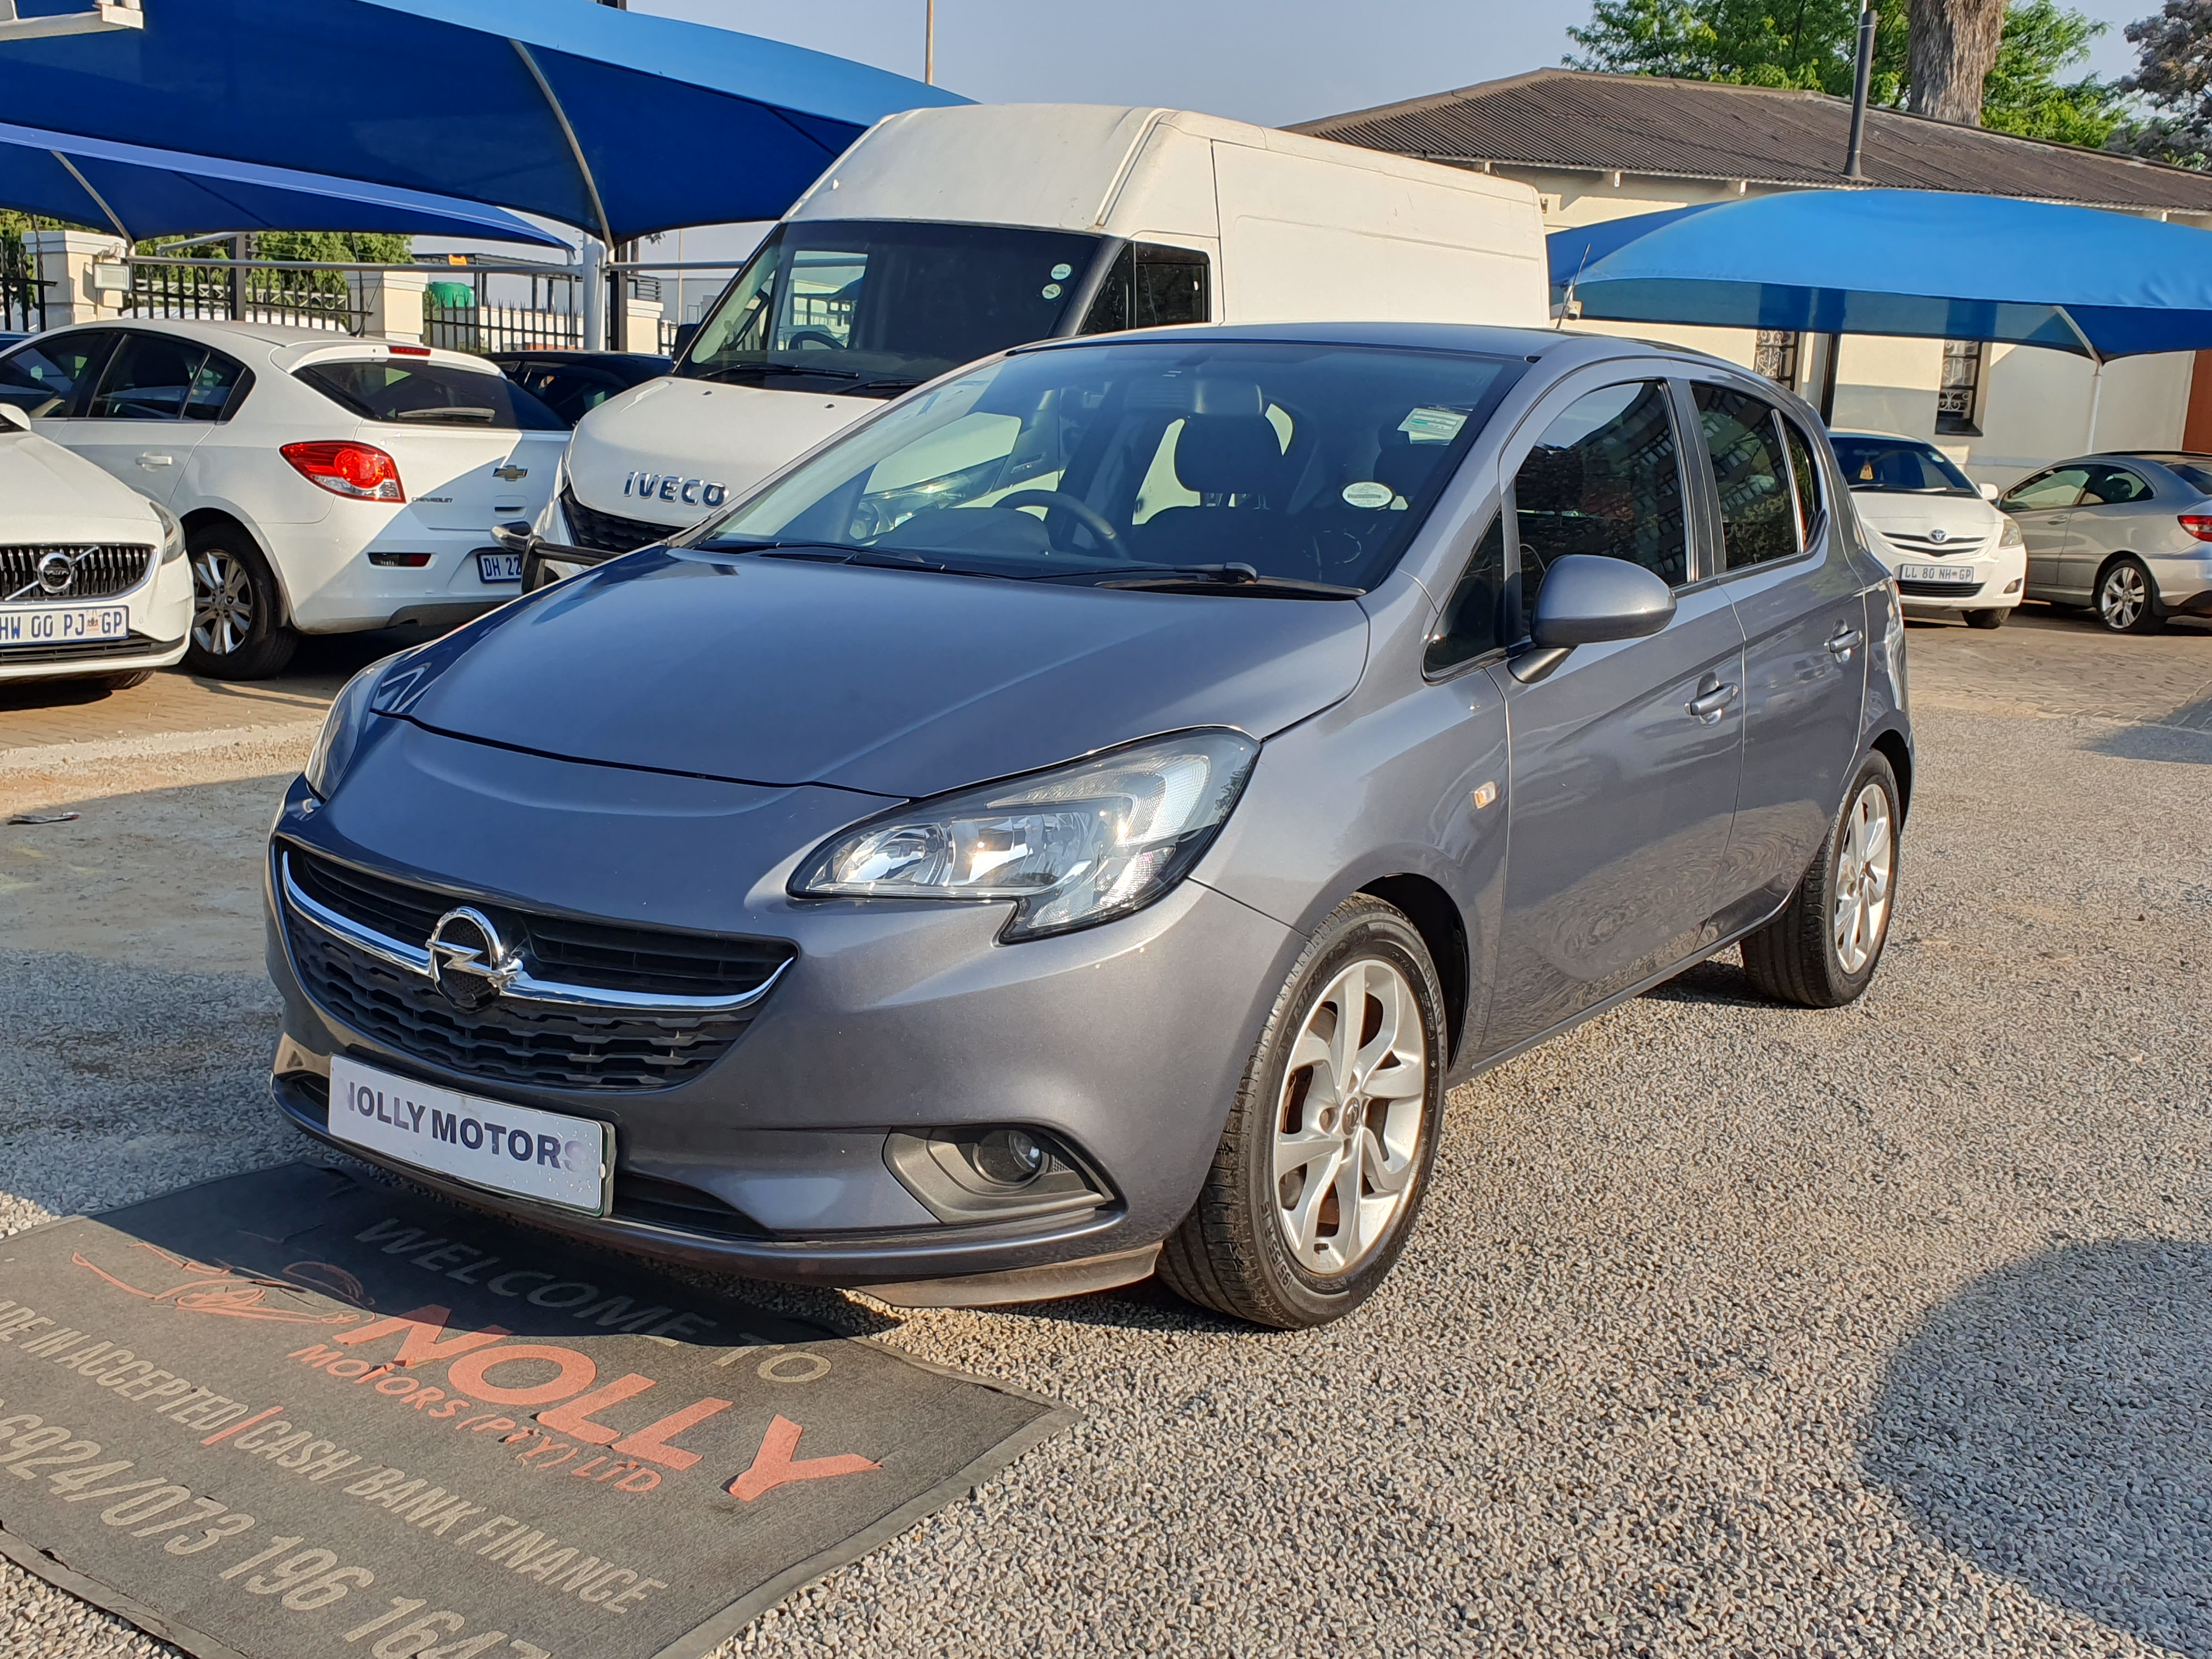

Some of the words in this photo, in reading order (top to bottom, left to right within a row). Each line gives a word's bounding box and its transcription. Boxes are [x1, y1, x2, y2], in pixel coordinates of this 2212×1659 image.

[624, 471, 730, 508] IVECO
[483, 557, 501, 577] DH
[505, 556, 521, 576] 22
[1904, 567, 1917, 578] LL
[1922, 567, 1935, 579] 80
[1938, 568, 1951, 580] NH
[1959, 569, 1971, 580] GP
[64, 613, 85, 637] PJ
[101, 611, 123, 635] GP
[354, 1217, 718, 1347] WELCOME
[712, 1331, 832, 1383] TO
[287, 1344, 470, 1418] MOTORS
[571, 1455, 662, 1493] LTD
[332, 1304, 883, 1502] NOLLY
[18, 1327, 92, 1358] IN
[454, 1514, 669, 1614] FINANCE
[219, 1535, 375, 1611] 196
